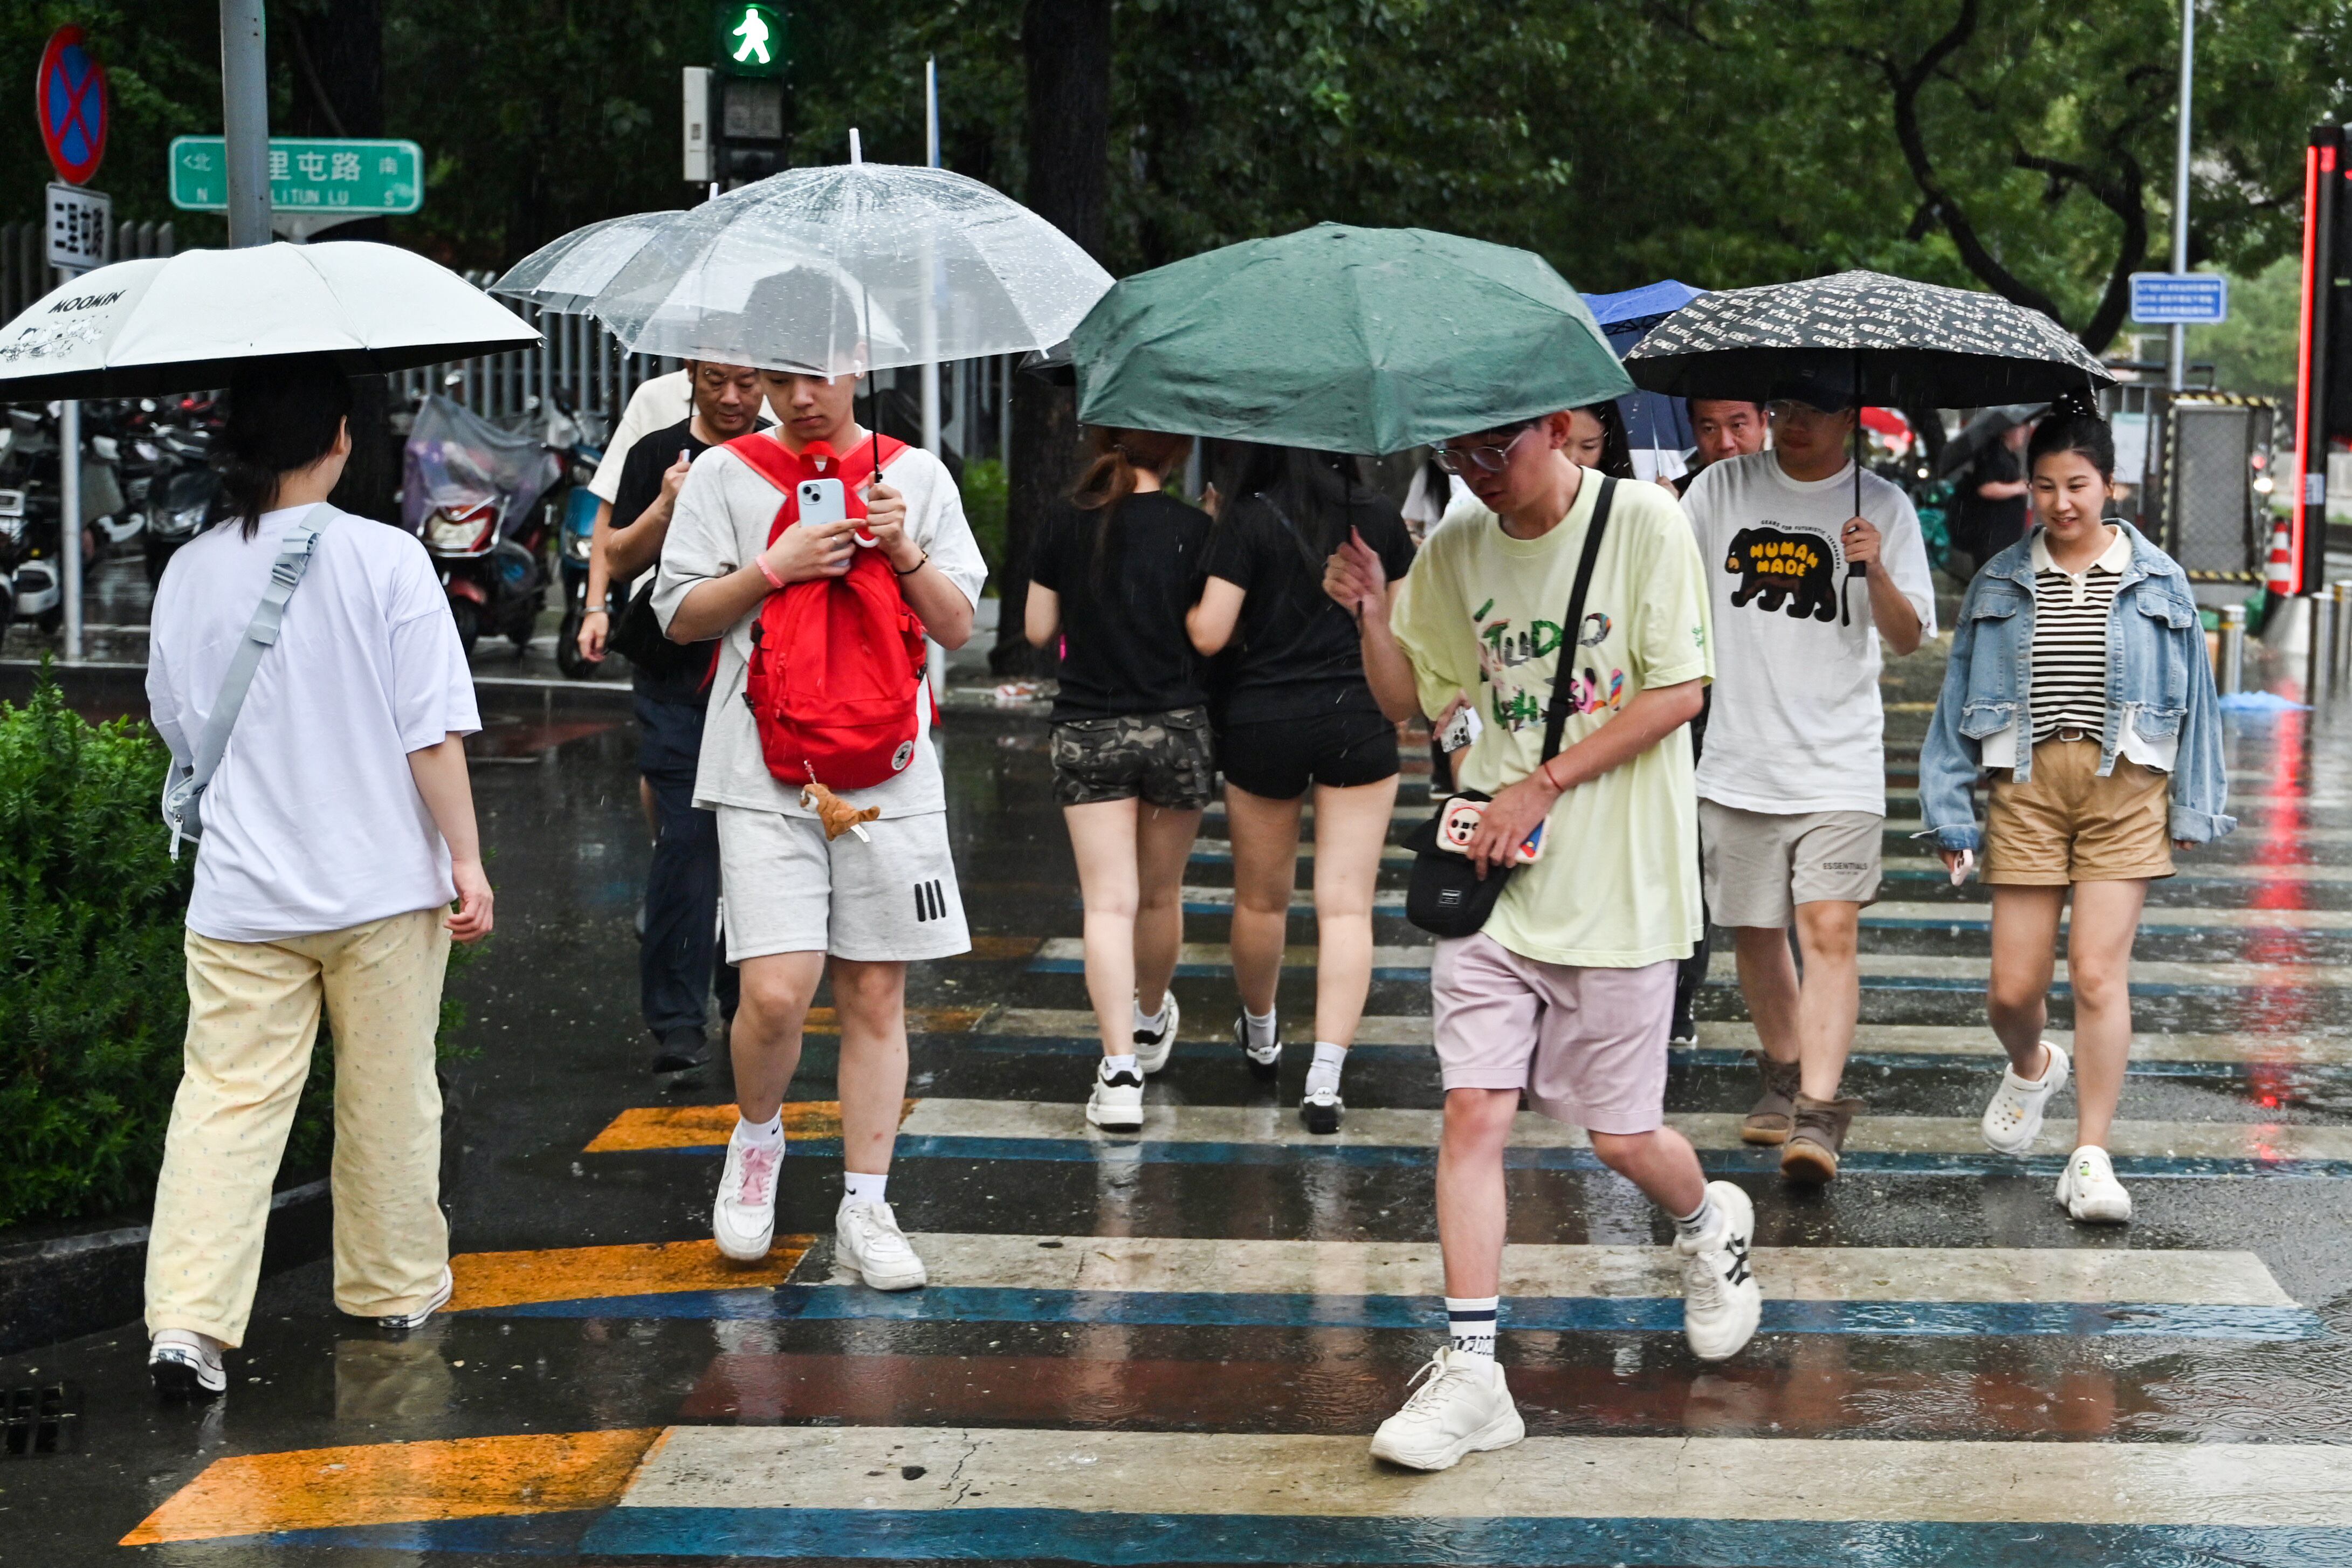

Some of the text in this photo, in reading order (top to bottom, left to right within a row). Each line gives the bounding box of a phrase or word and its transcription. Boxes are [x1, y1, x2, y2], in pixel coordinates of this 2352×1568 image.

[379, 156, 397, 175] 南
[196, 188, 208, 202] N
[328, 190, 349, 205] LU
[383, 190, 395, 207] S
[47, 289, 128, 314] MOOMIN
[1768, 308, 1808, 324] PARTY
[1811, 306, 1854, 320] GREEN
[1869, 311, 1910, 325] PARTY
[1750, 541, 1819, 568] HUMAN
[1756, 558, 1807, 576] MADE
